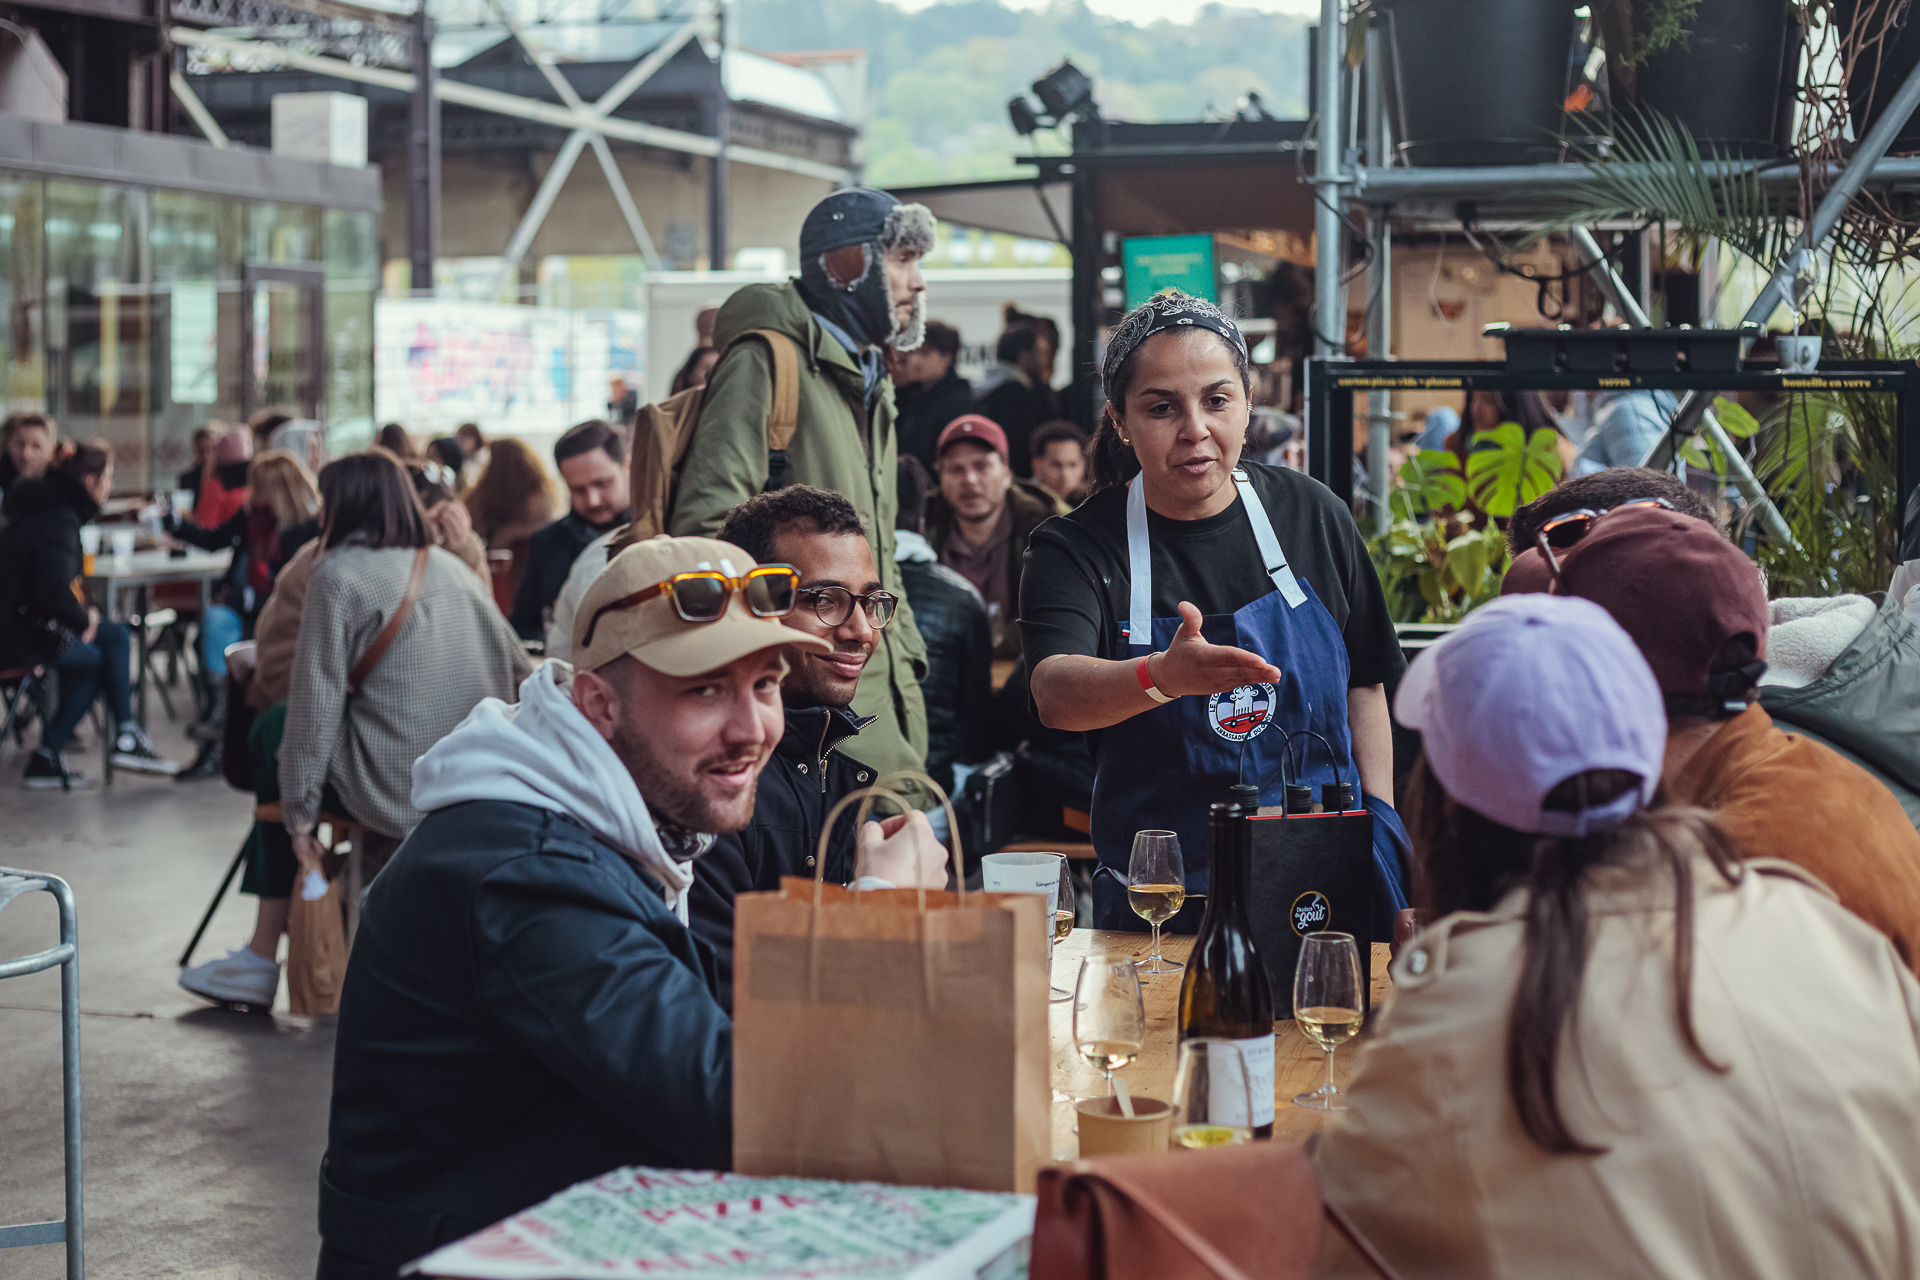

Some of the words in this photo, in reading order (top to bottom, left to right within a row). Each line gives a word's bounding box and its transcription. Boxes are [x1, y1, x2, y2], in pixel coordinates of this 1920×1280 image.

[1782, 377, 1827, 388] bouteille
[1829, 379, 1842, 388] en
[1843, 379, 1872, 388] verre
[1209, 703, 1216, 713] LE
[1215, 726, 1253, 740] AMBASSADER
[1253, 726, 1262, 736] DU
